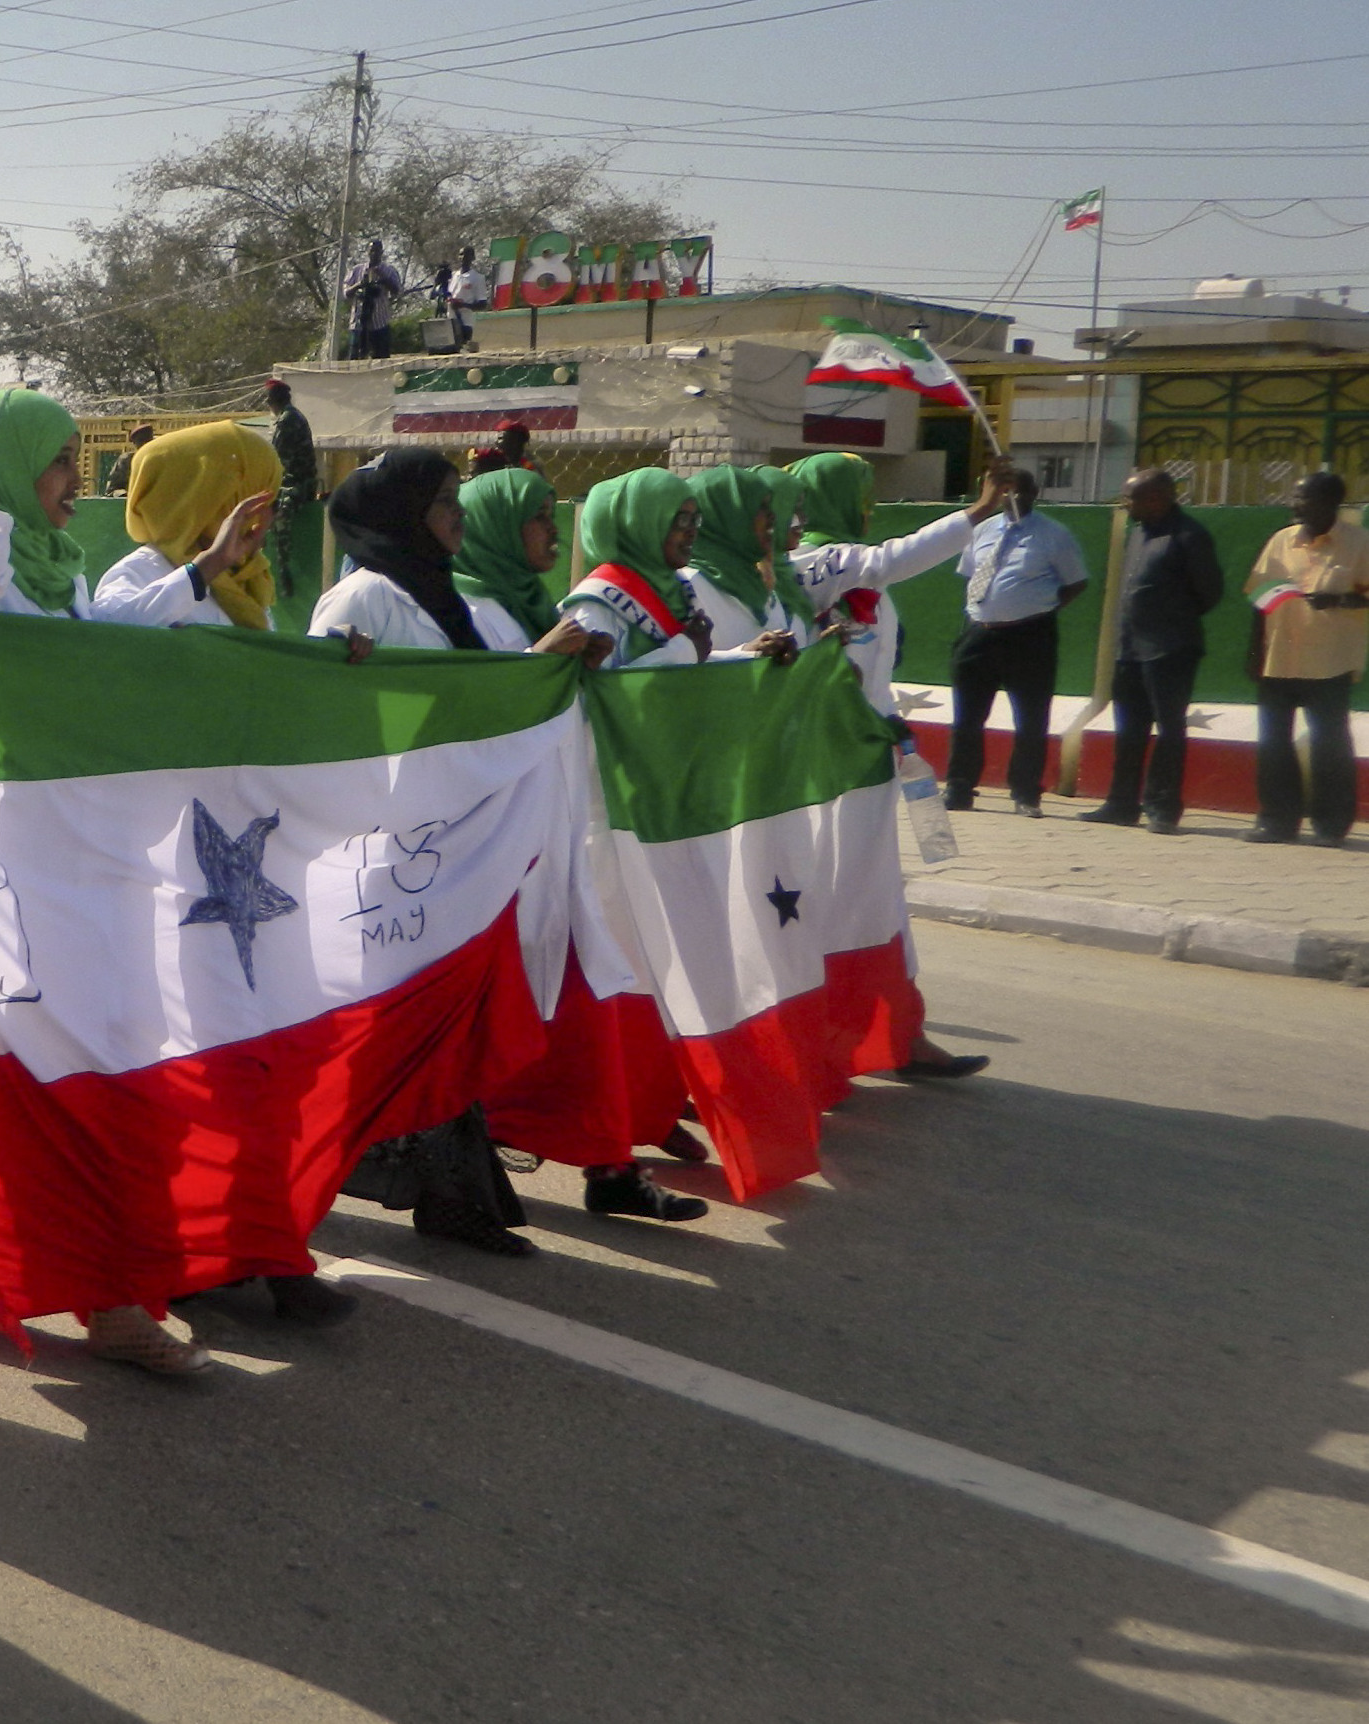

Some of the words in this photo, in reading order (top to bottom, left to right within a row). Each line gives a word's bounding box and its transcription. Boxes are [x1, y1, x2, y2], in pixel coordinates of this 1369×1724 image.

[490, 231, 573, 311] 18
[574, 236, 712, 305] MAY
[339, 820, 447, 921] 18
[361, 903, 425, 953] MAY
